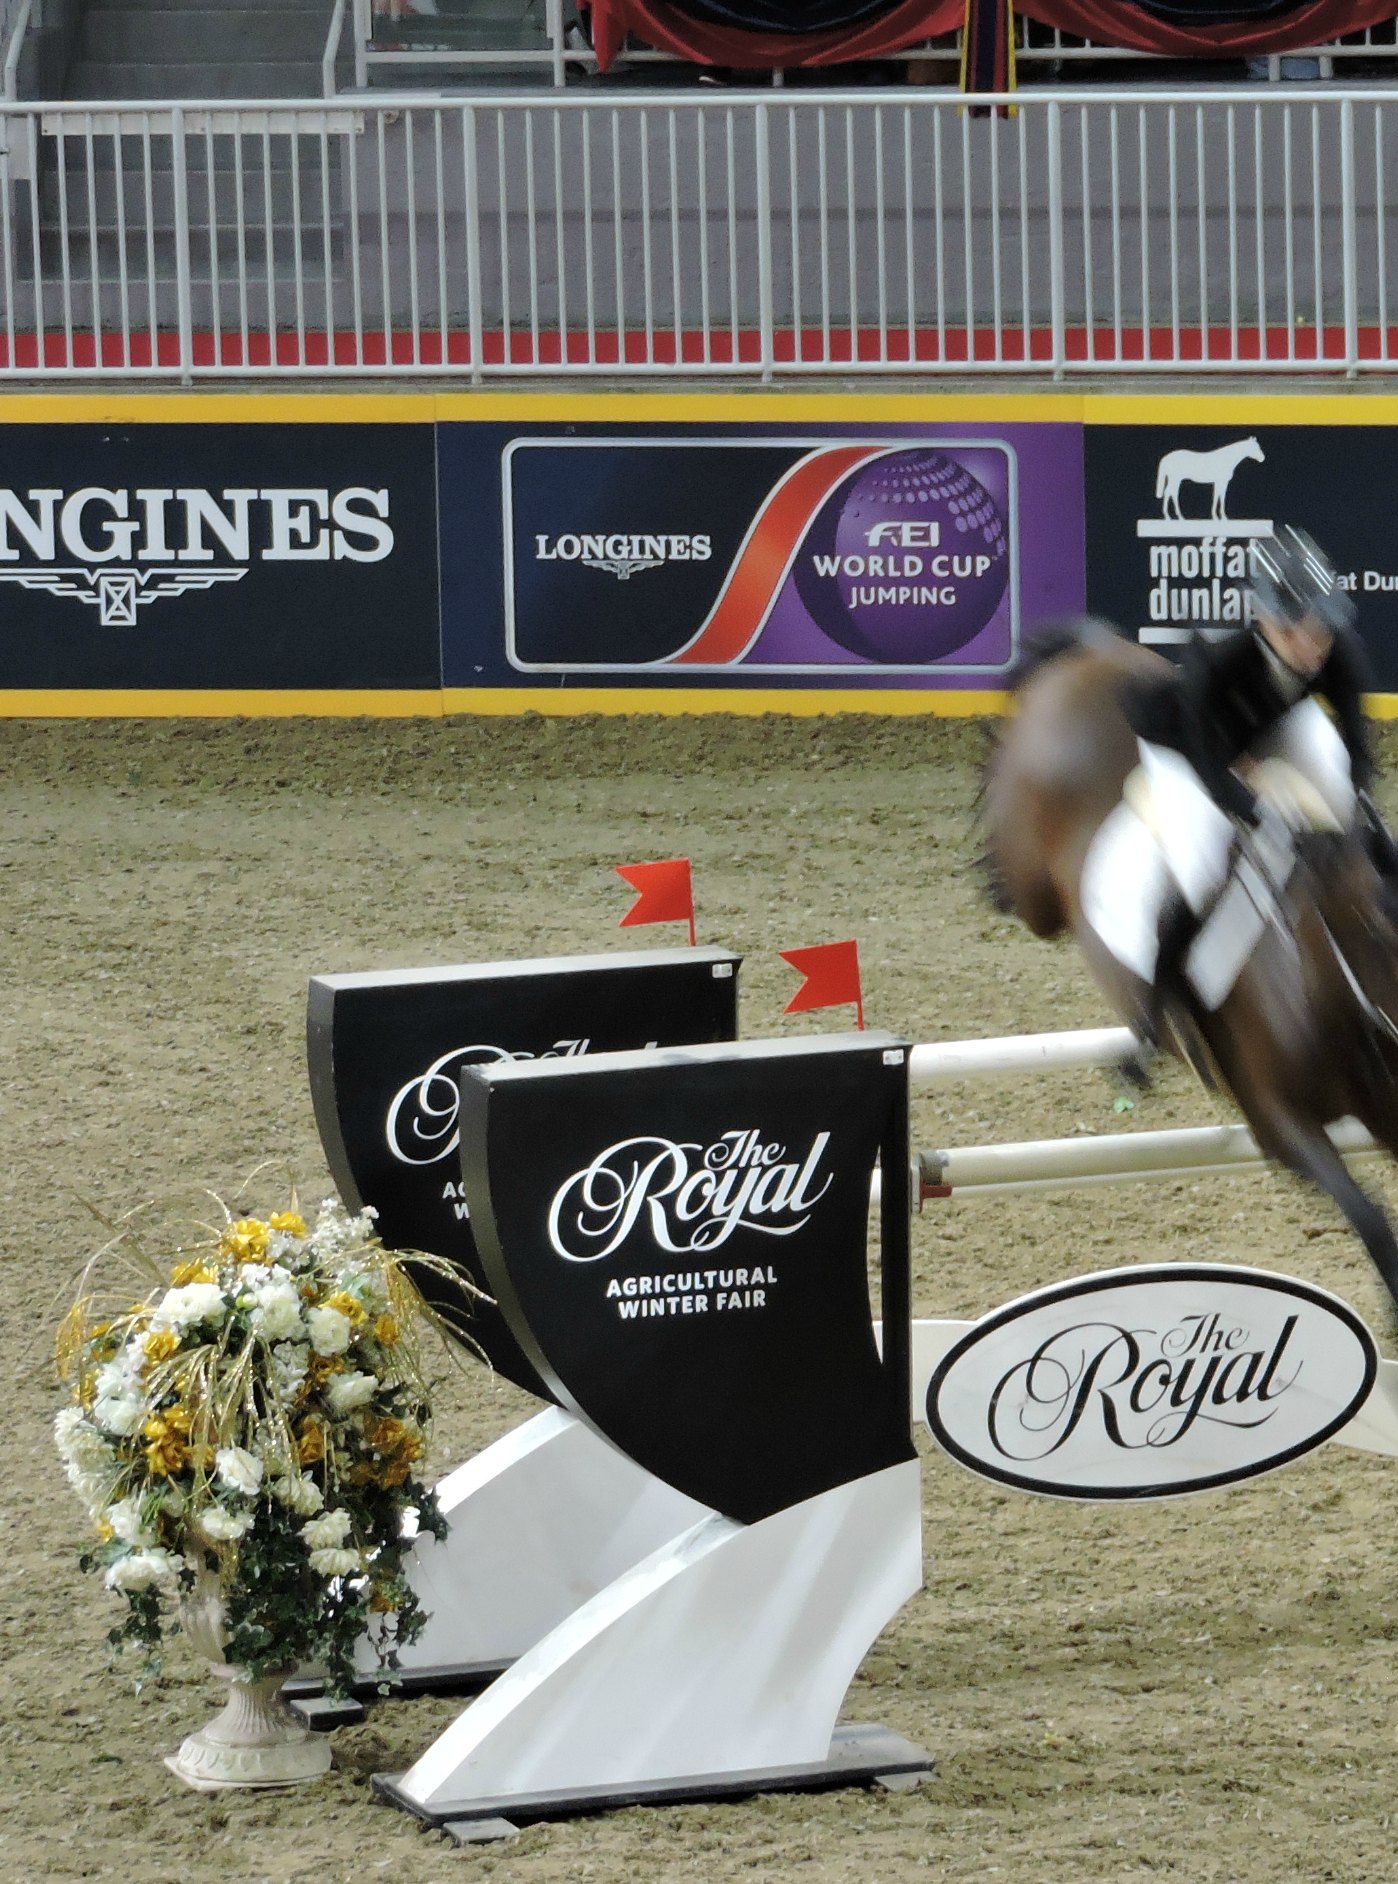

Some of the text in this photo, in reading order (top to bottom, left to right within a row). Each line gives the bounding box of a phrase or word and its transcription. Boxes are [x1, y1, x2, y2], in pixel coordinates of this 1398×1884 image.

[0, 487, 394, 562] NGINES
[536, 534, 712, 561] LONGINES
[813, 555, 991, 578] WORLD CUP
[849, 586, 956, 609] JUMPING
[704, 1129, 786, 1170] The
[549, 1132, 833, 1262] Royal
[606, 1265, 778, 1298] AGRICULTURAL
[619, 1289, 766, 1319] WINTER FAIR
[1161, 1313, 1250, 1357] The
[987, 1315, 1303, 1460] Royal
